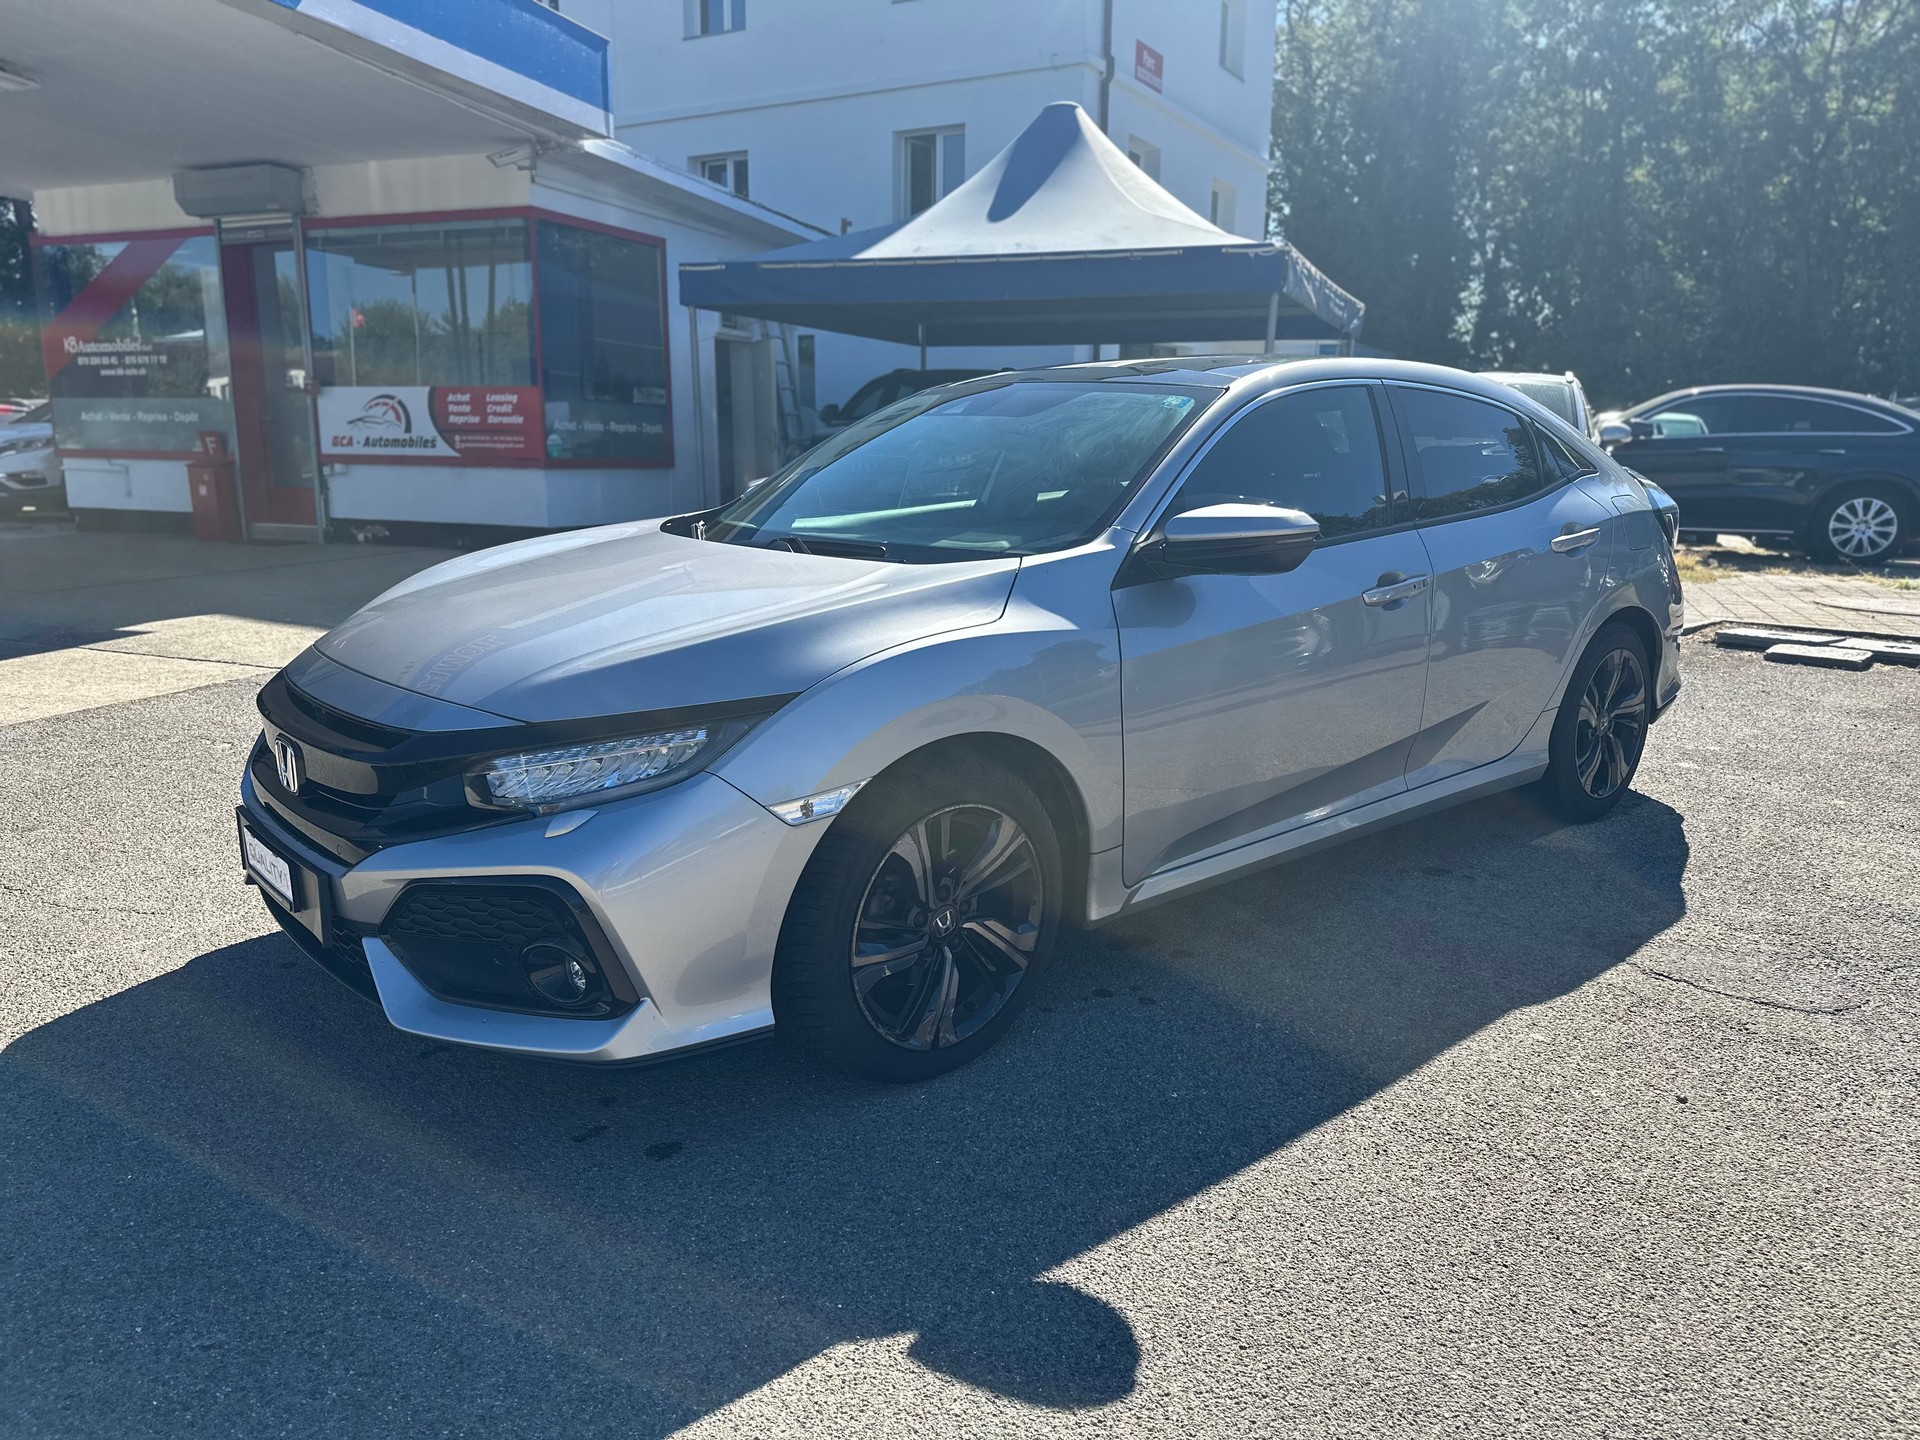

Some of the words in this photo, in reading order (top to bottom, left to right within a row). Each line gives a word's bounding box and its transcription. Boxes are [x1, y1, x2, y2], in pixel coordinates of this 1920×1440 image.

[447, 393, 471, 402] Achat
[485, 393, 518, 405] Leasing
[448, 404, 471, 413] Vente
[137, 411, 168, 423] Reprise
[448, 414, 480, 425] Reprise
[487, 414, 524, 424] Garantie
[610, 421, 637, 433] Reprise
[332, 435, 353, 447] GCA
[363, 435, 438, 448] Automobiles
